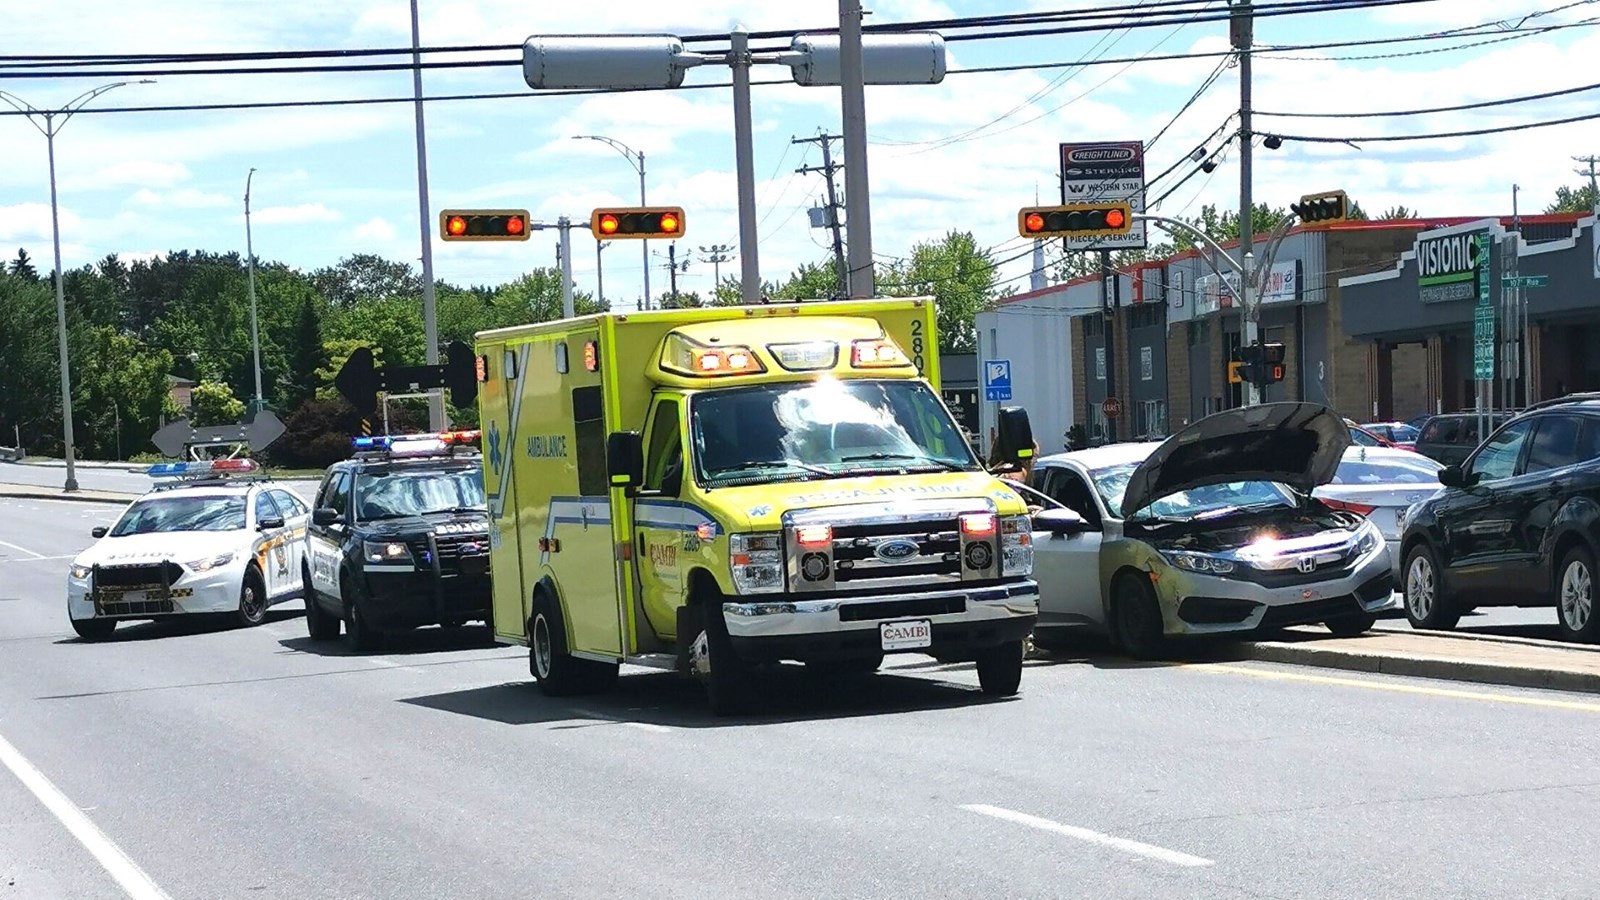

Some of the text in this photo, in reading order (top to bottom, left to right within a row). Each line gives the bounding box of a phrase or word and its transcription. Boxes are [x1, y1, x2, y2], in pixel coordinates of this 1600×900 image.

[1074, 150, 1129, 160] FREIGHTLINER
[1084, 166, 1140, 175] STERLING
[1088, 182, 1120, 192] WESTERN
[1122, 182, 1139, 191] STAR
[1107, 233, 1141, 241] SERVICE
[527, 434, 568, 458] AMBULANCE
[650, 543, 677, 567] CAMBI
[888, 545, 909, 556] Ford
[883, 626, 929, 640] CAMBI
